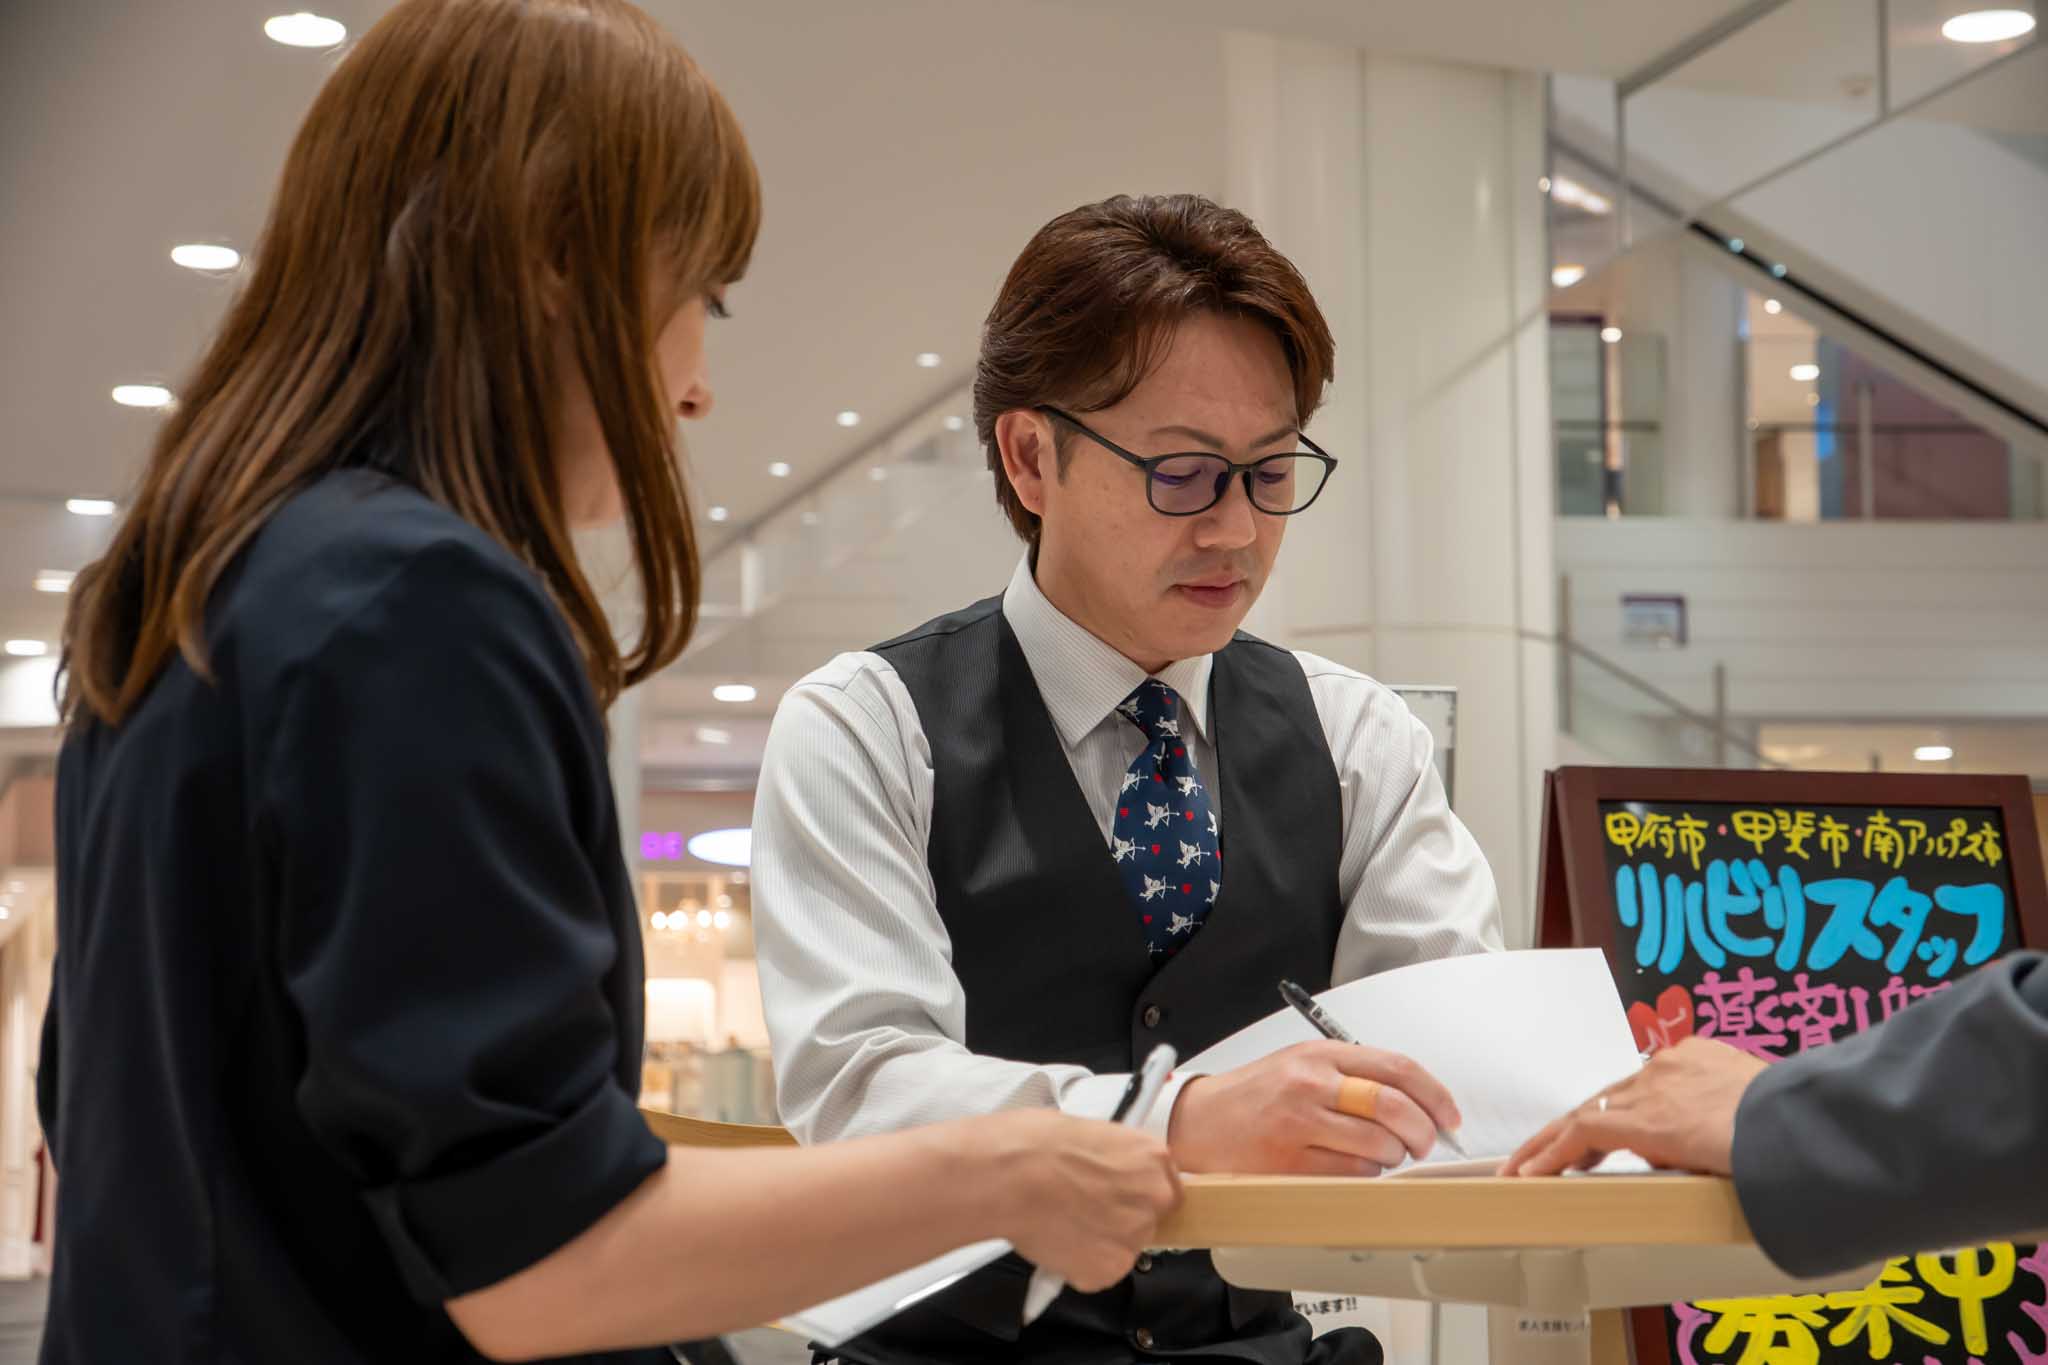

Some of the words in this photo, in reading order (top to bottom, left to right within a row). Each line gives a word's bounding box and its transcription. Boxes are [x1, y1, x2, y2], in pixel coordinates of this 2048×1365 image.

[1615, 858, 2006, 977] リハビリスタッフ
